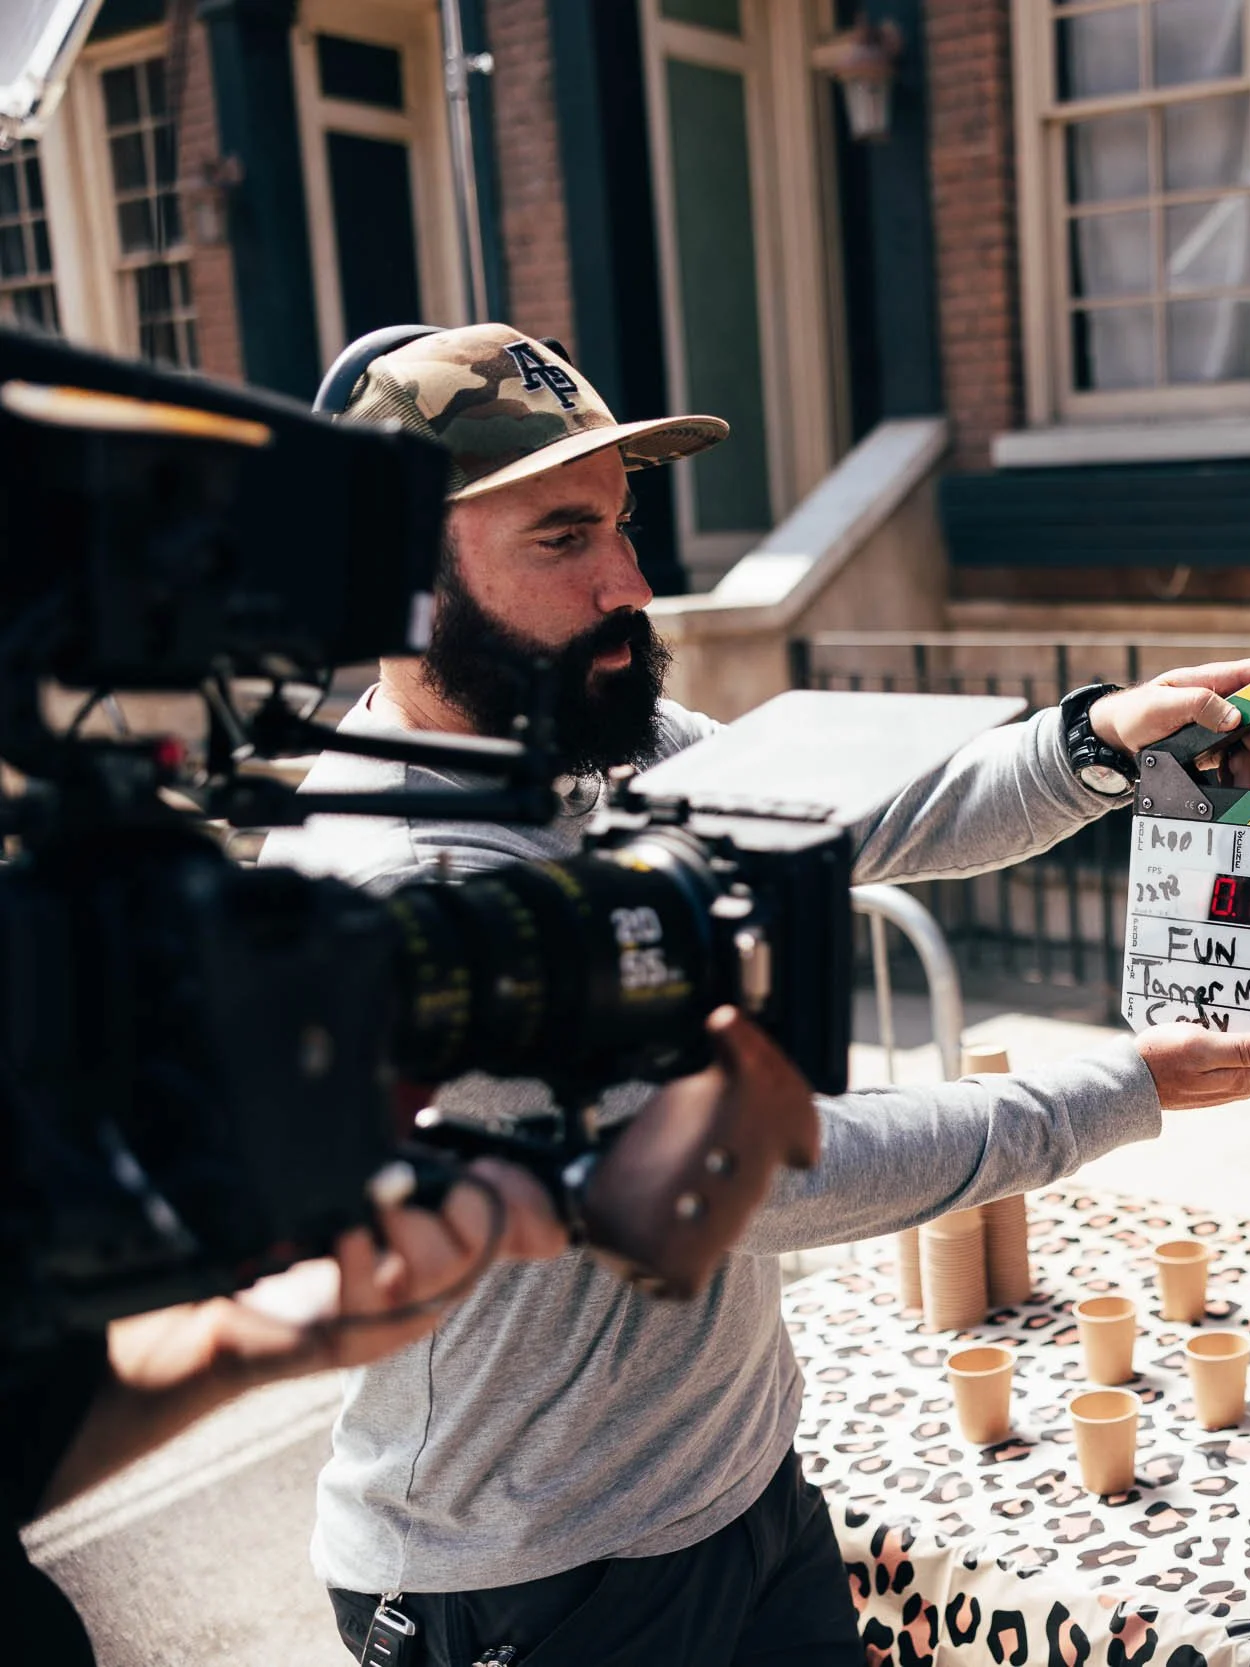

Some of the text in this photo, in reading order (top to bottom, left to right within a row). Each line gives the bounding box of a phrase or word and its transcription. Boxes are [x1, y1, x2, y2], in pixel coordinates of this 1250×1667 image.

[1235, 831, 1244, 869] SCENE
[1147, 866, 1162, 875] FPS
[1168, 926, 1236, 966] FUN
